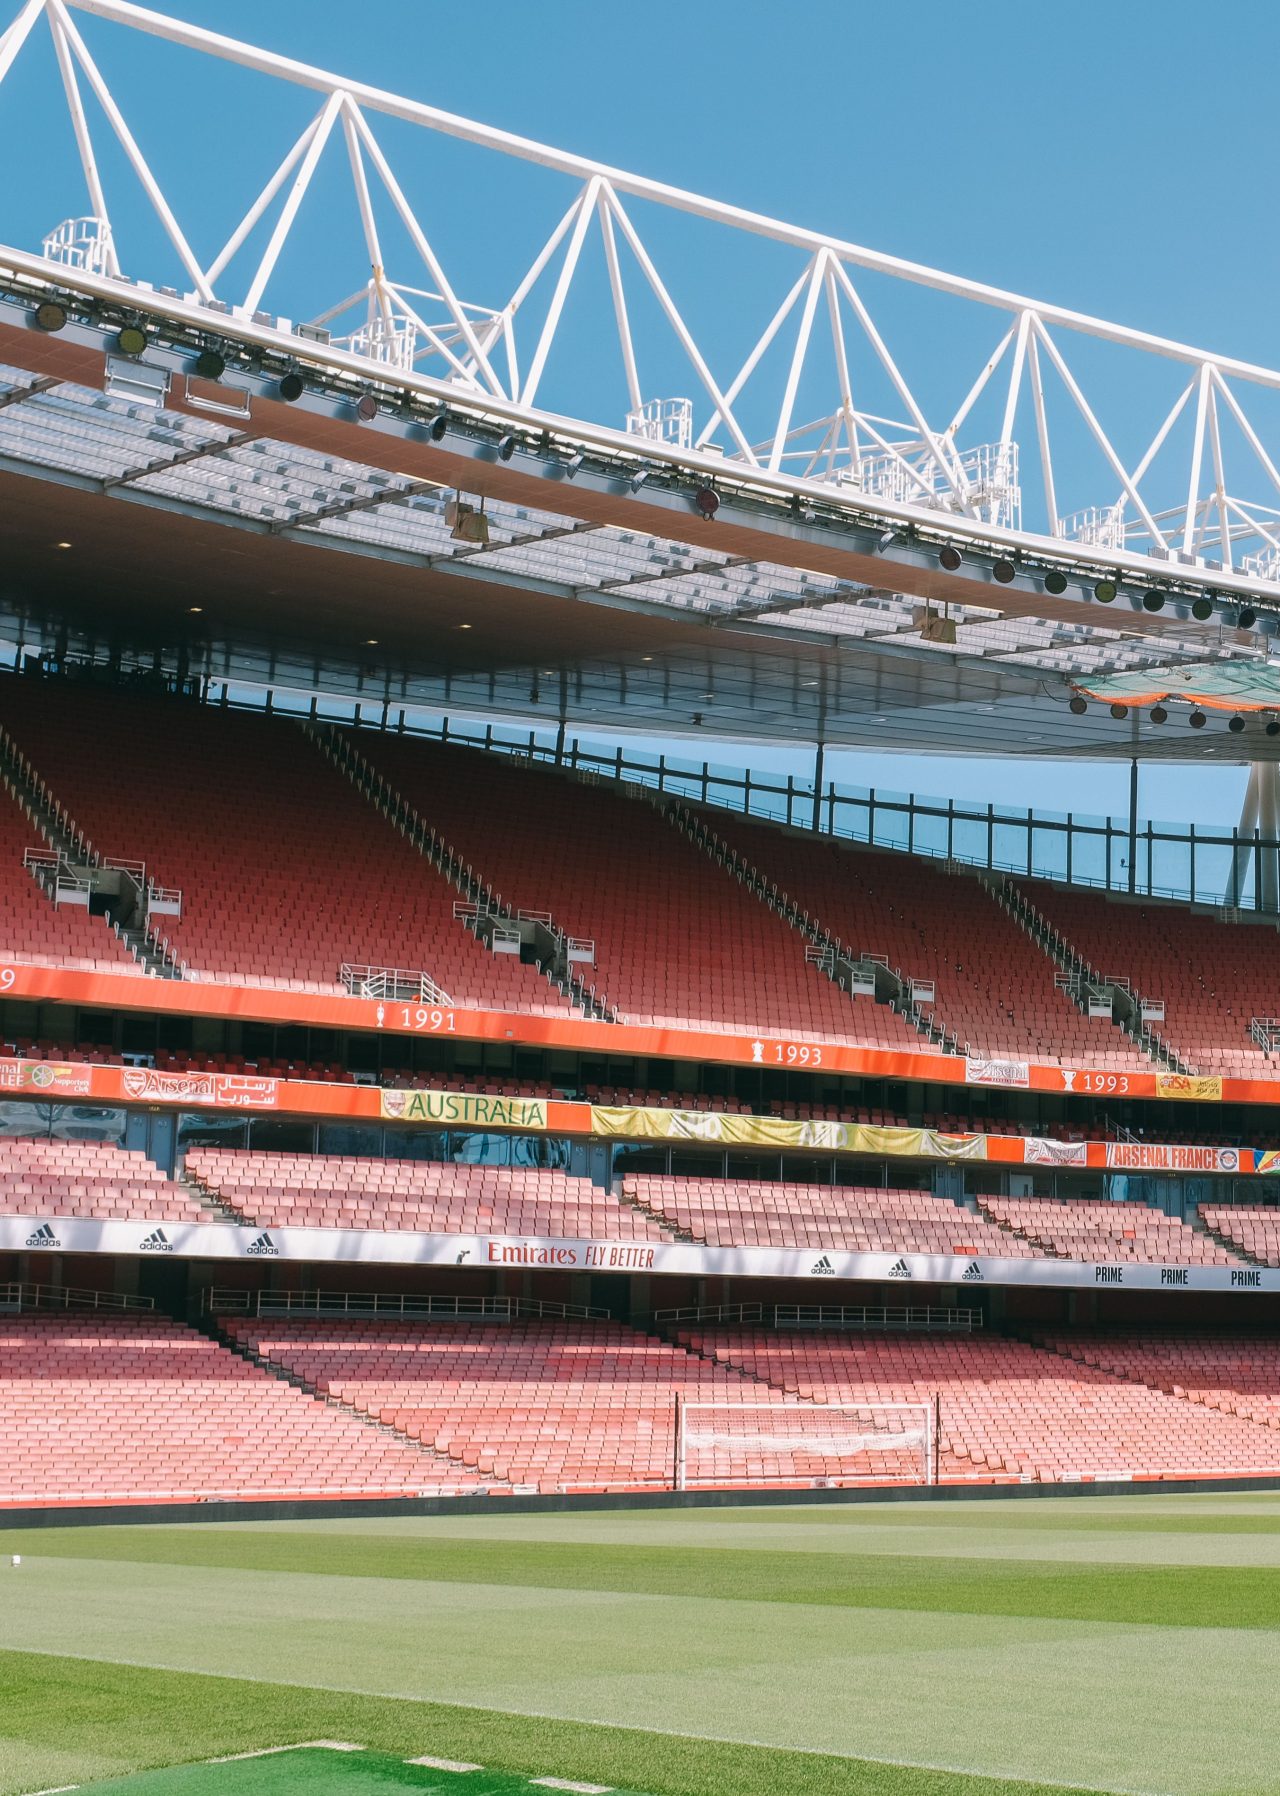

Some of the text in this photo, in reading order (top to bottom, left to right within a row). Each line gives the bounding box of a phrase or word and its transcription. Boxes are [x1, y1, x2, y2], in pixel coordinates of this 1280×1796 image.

[401, 1008, 455, 1031] 1991
[775, 1044, 822, 1065] 1993
[146, 1072, 215, 1094] Arsenal
[1083, 1073, 1128, 1093] 1993
[409, 1093, 544, 1126] AUSTRALIA
[1114, 1145, 1219, 1169] ARSENAL FRANCE
[26, 1237, 61, 1248] adidas
[140, 1241, 173, 1251] adidas
[247, 1245, 279, 1255] adidas
[488, 1242, 654, 1268] Emirates FLY BETTER
[811, 1267, 836, 1276] adidas
[888, 1270, 912, 1279] adidas
[961, 1273, 985, 1281] adidas
[1095, 1267, 1122, 1283] PRIME
[1161, 1269, 1188, 1285] PRIME
[1231, 1270, 1261, 1287] PRIME
